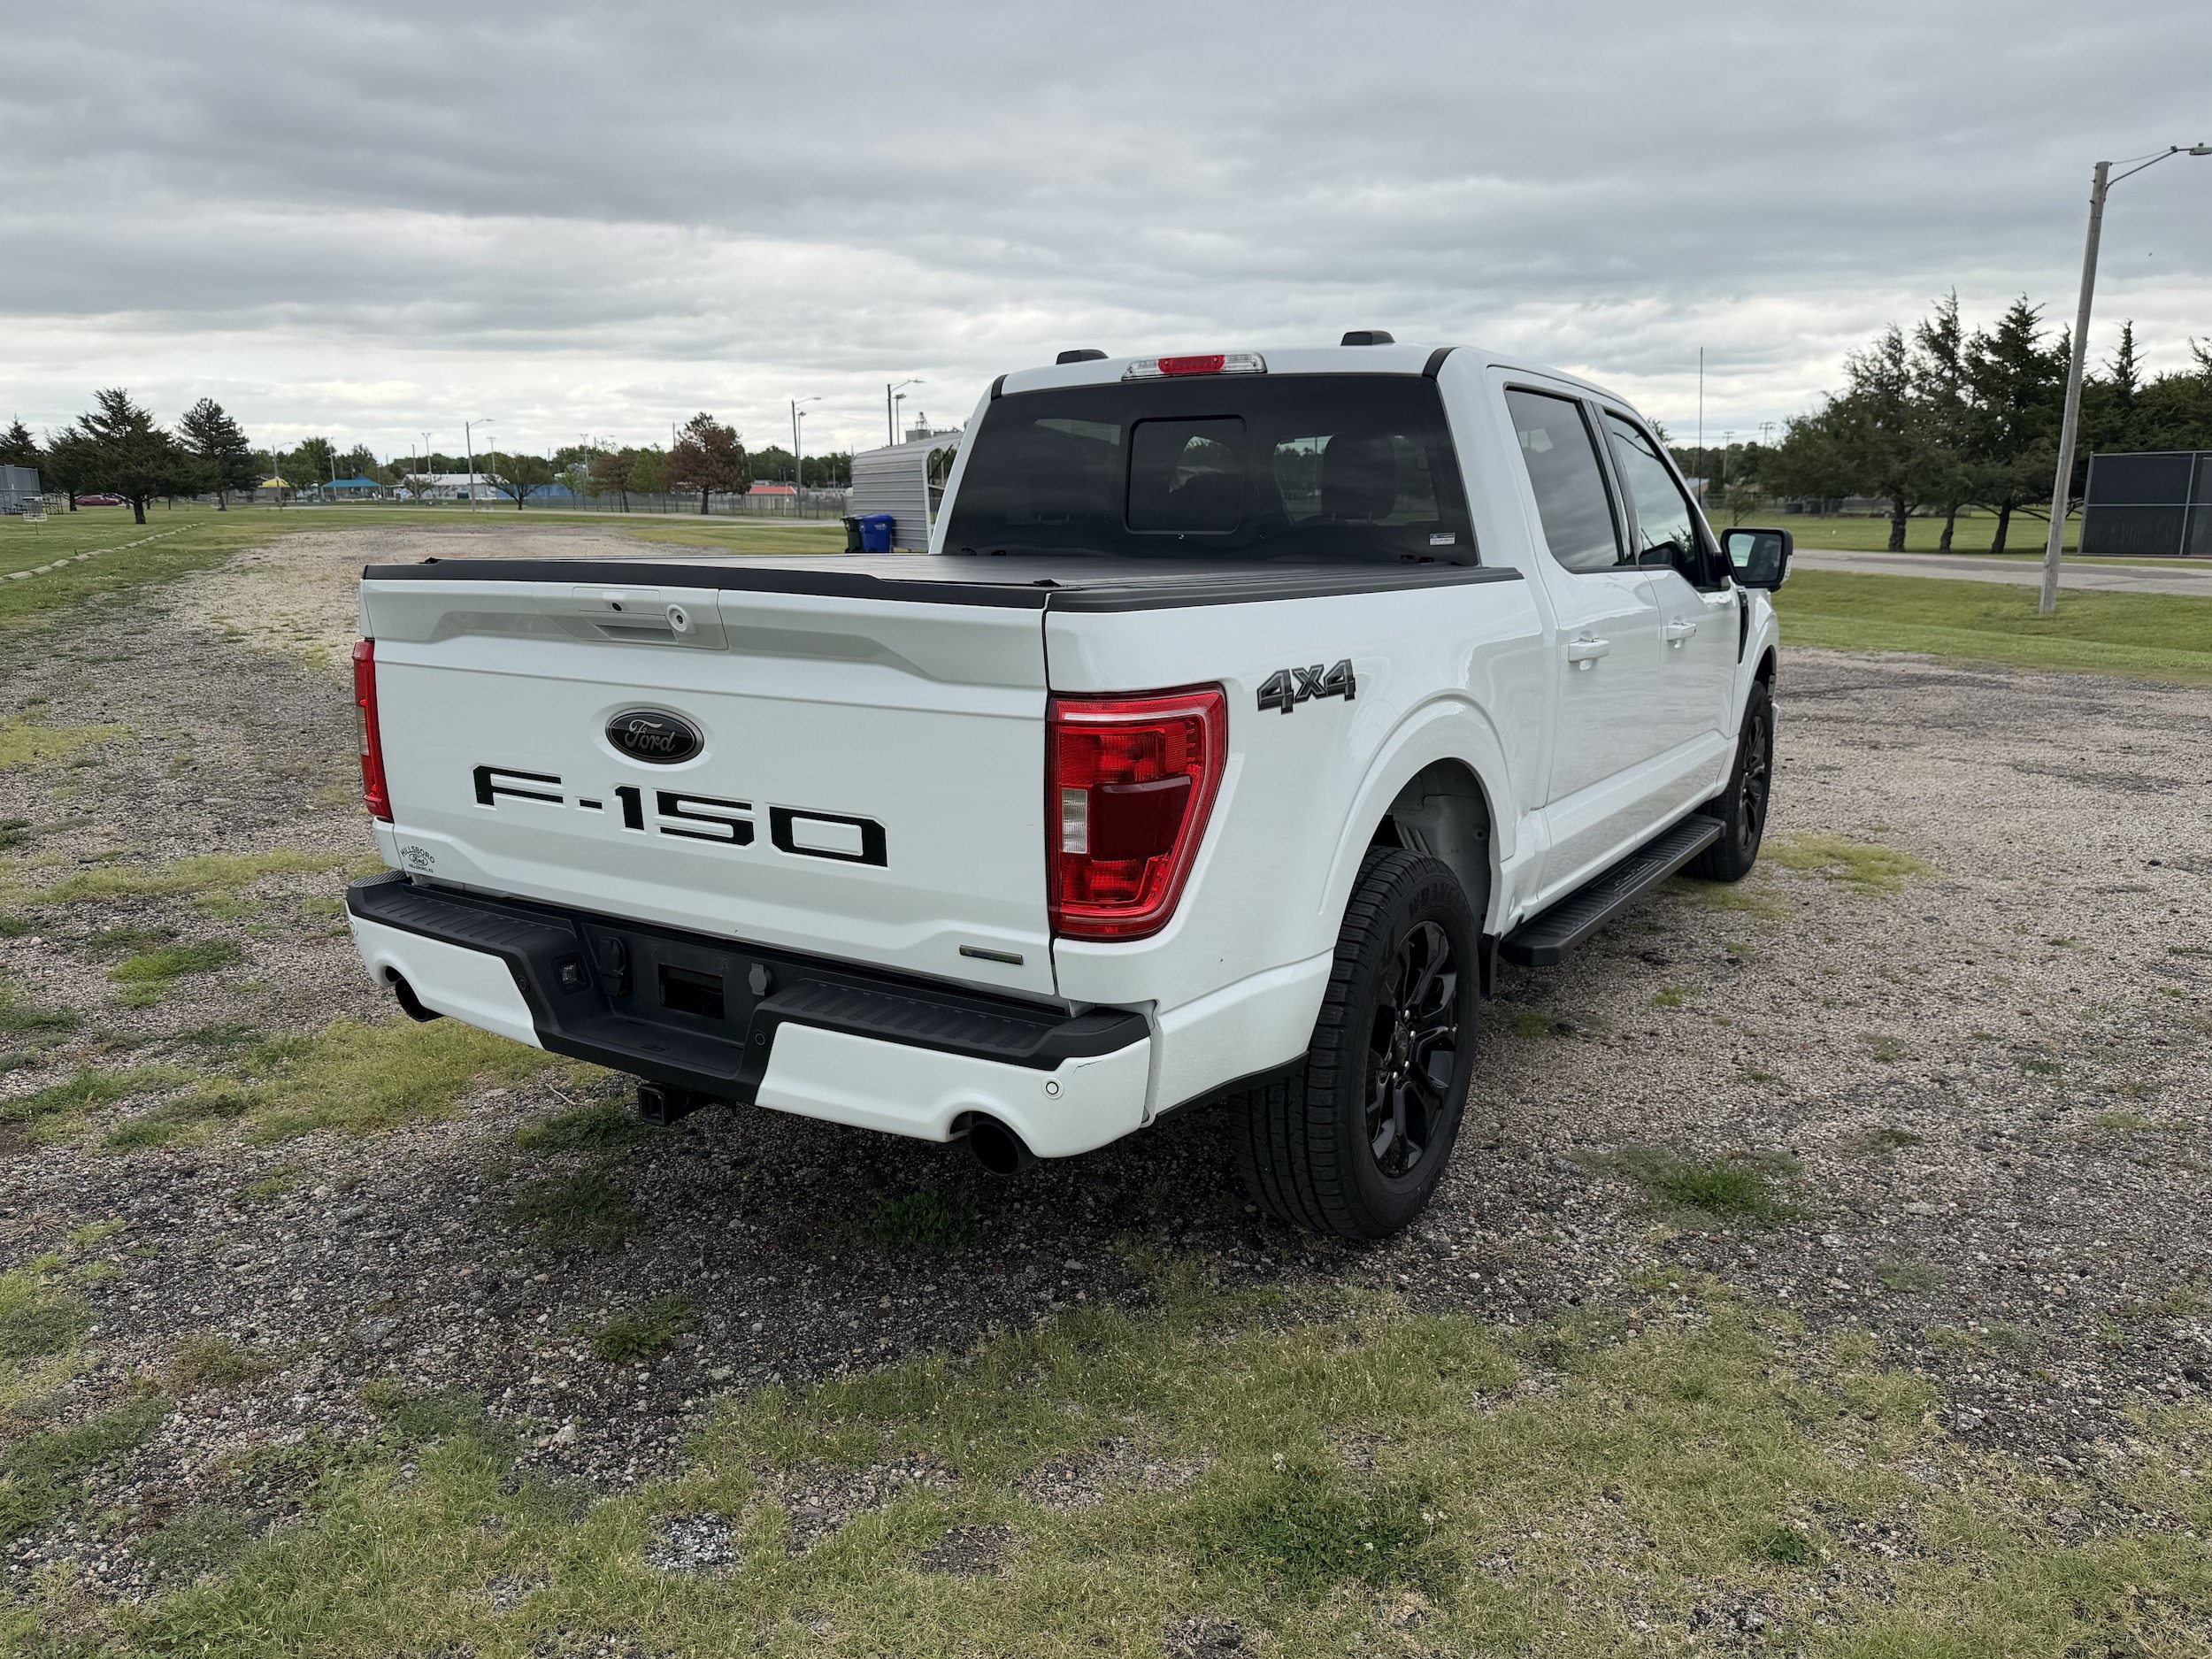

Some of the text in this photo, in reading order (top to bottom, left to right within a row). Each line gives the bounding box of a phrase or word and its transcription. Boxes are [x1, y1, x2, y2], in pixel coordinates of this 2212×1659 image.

[1256, 658, 1356, 715] 4X4
[624, 718, 676, 752] Ford
[472, 764, 888, 867] F-150
[400, 846, 435, 864] HILLSBORO
[411, 855, 426, 864] Ford
